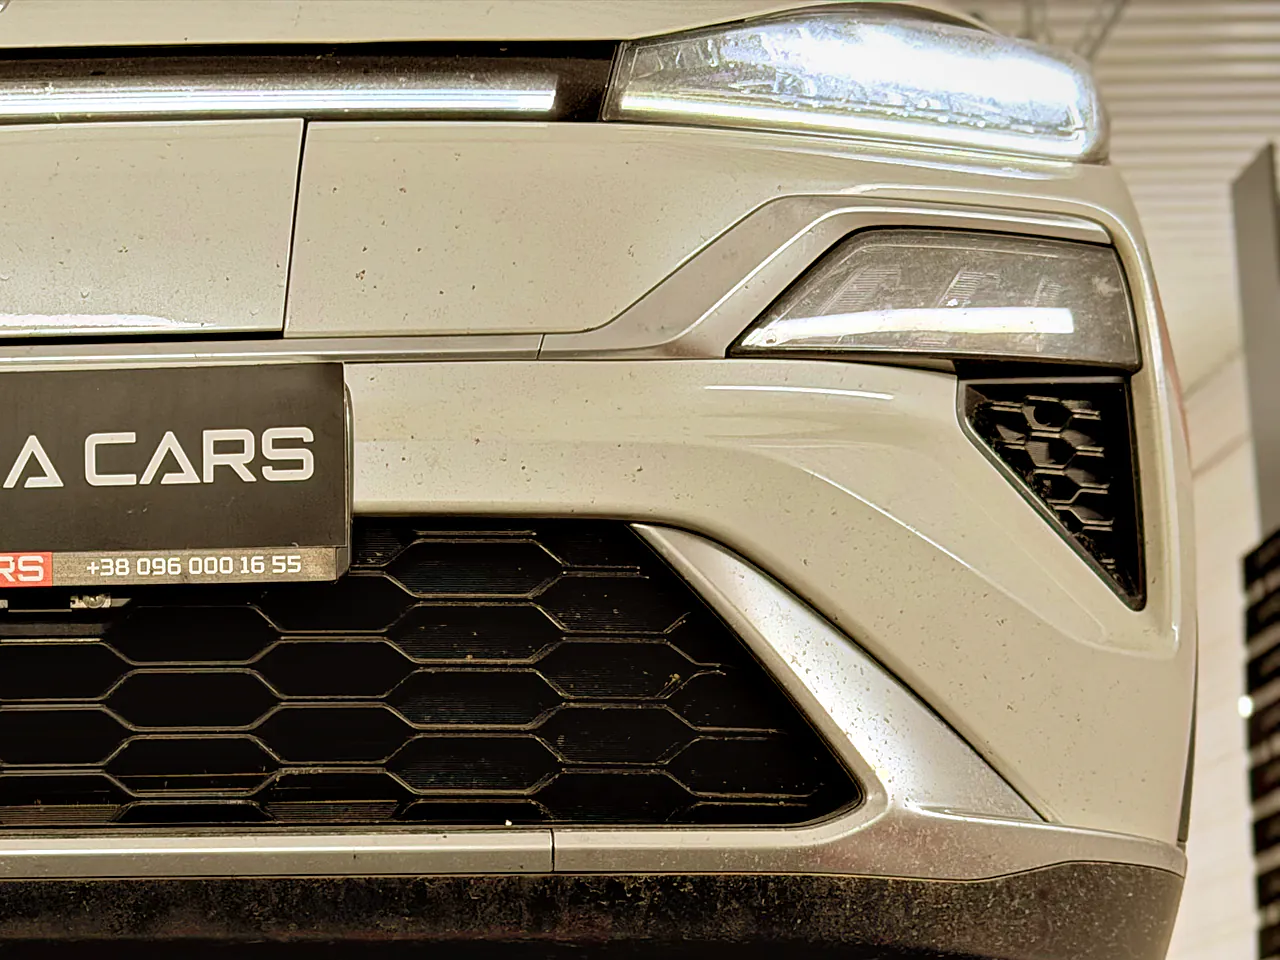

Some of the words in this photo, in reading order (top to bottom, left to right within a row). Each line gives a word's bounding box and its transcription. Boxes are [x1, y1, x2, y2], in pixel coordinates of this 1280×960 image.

[84, 426, 316, 487] CARS
[86, 557, 130, 577] +38
[136, 557, 182, 576] 096
[188, 556, 234, 575] 000
[240, 555, 266, 574] 16
[271, 554, 302, 574] 55
